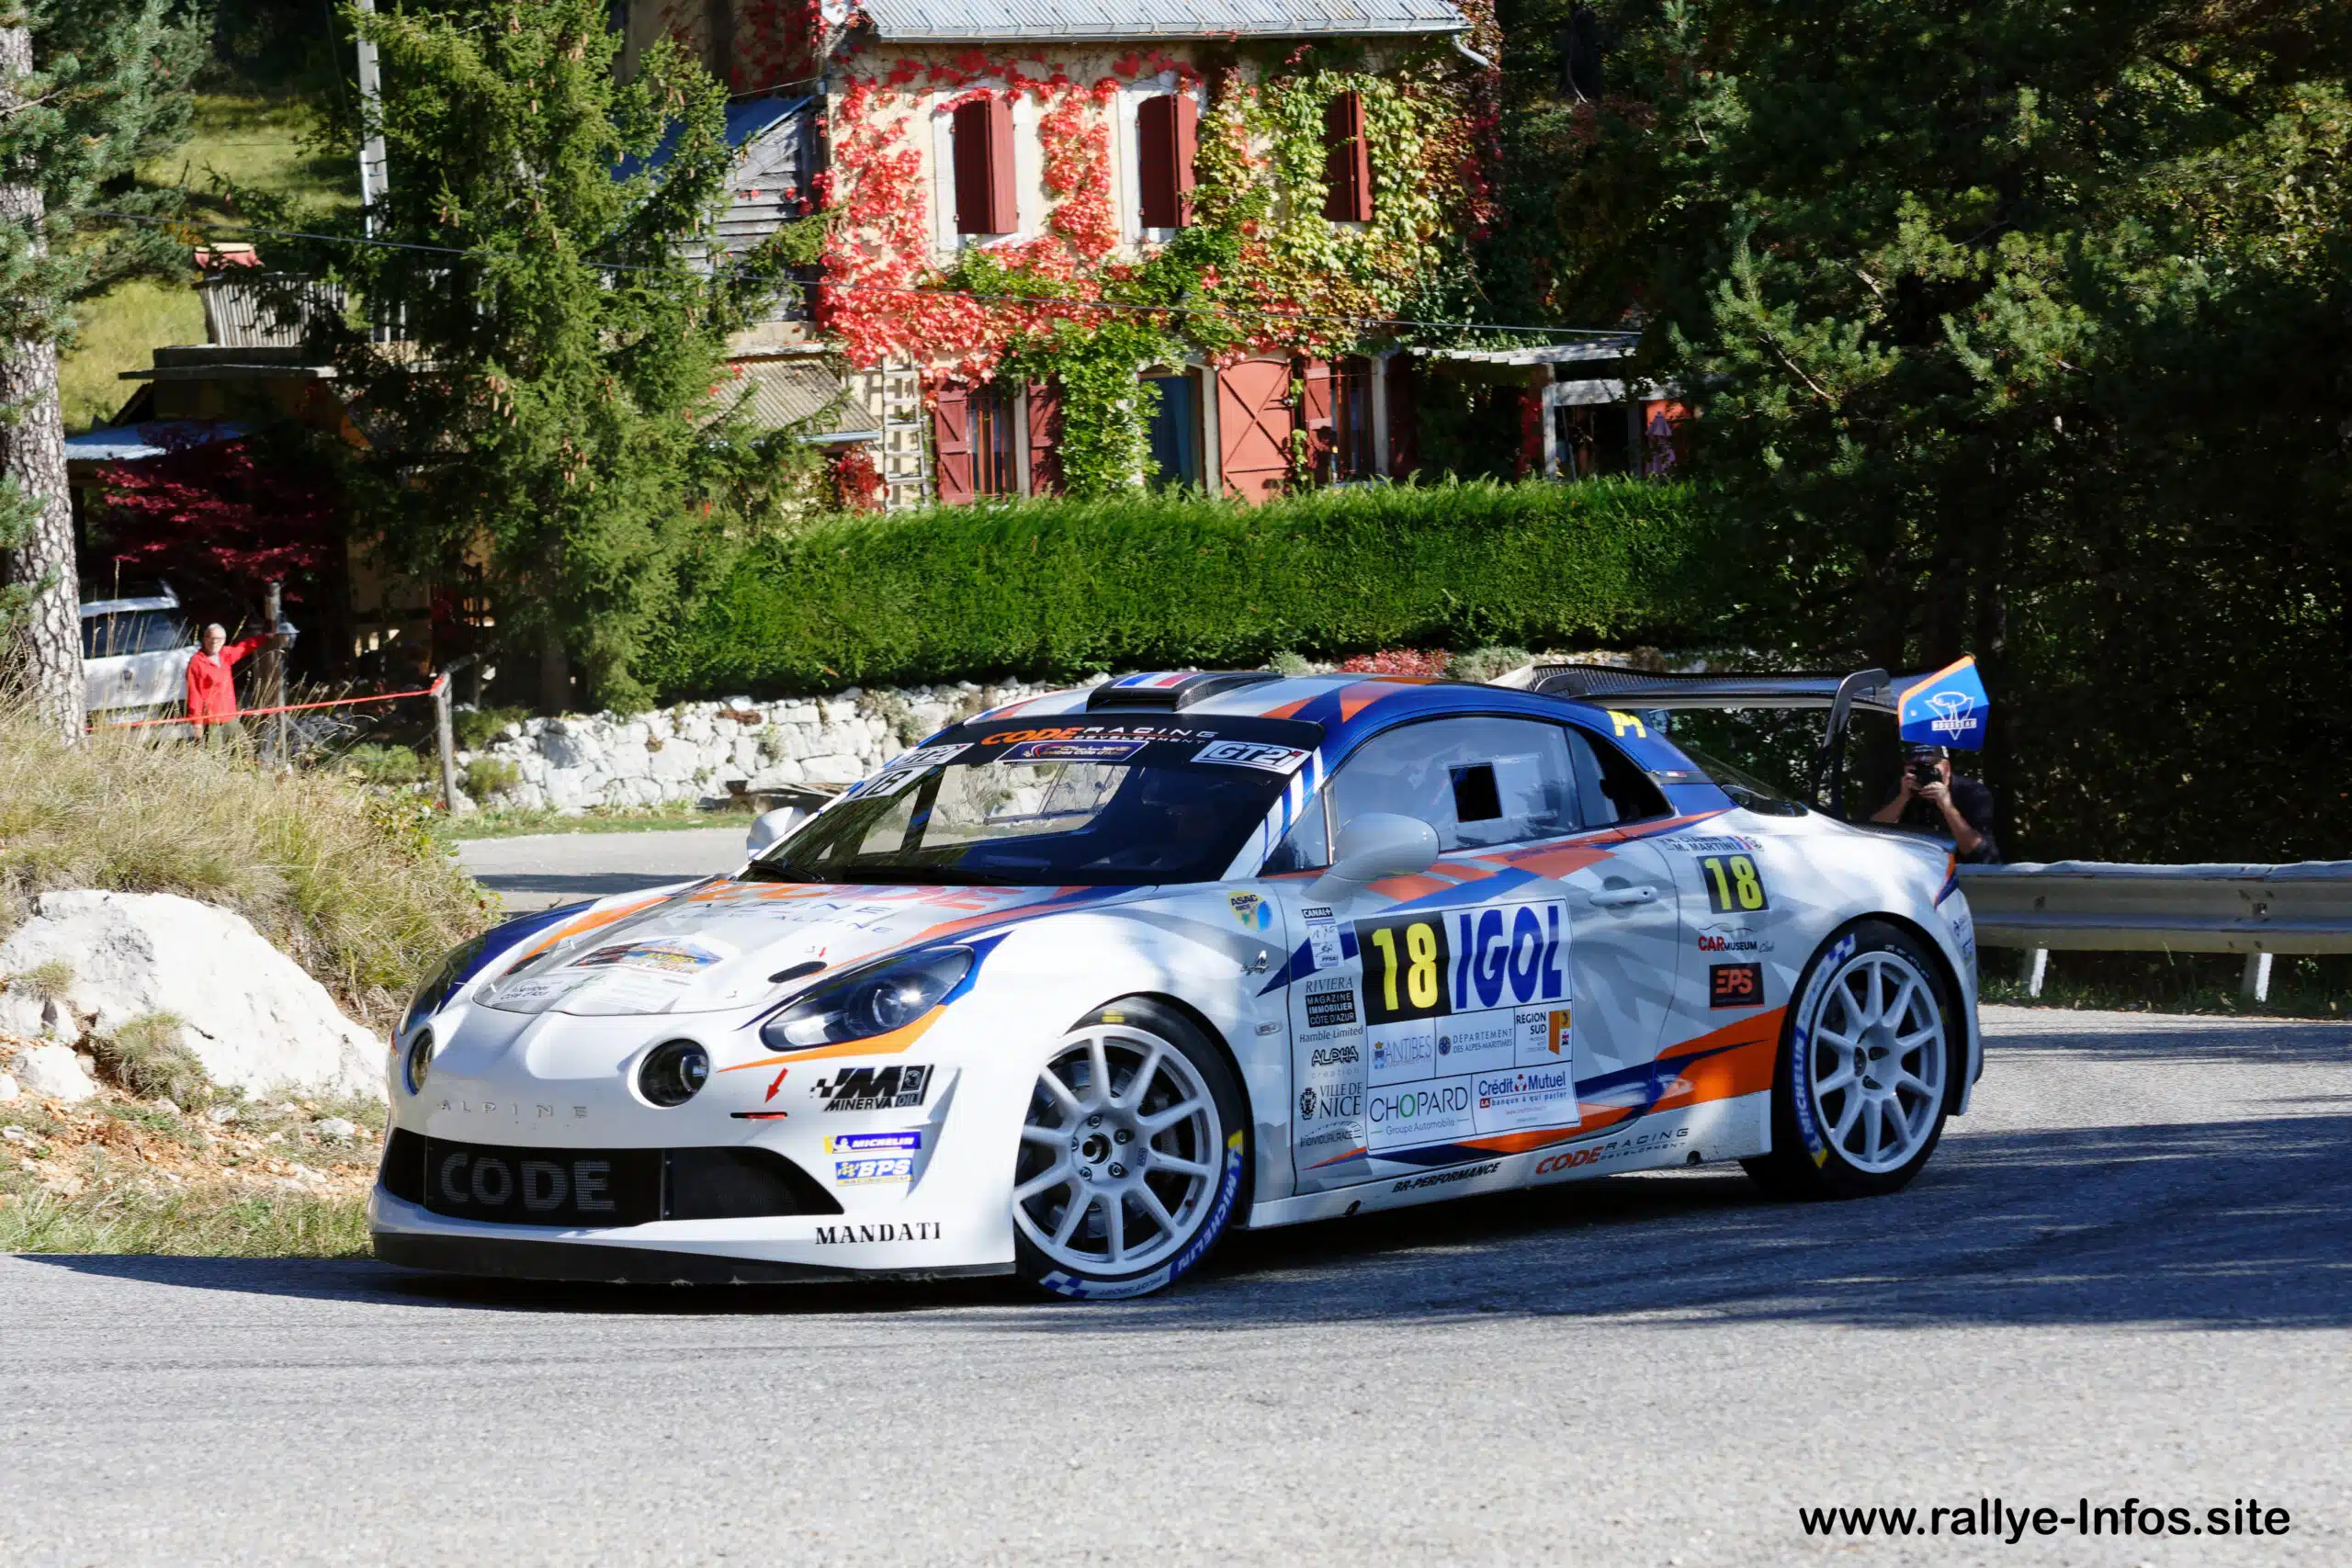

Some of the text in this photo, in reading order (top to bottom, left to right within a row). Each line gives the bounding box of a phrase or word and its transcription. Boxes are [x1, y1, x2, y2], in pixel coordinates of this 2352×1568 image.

[980, 726, 1218, 746] CODE RACING
[1073, 735, 1205, 746] DEVELOPMENT
[1689, 840, 1738, 852] MARTINI
[1704, 855, 1763, 910] 18
[1230, 894, 1258, 906] ASAC
[1303, 908, 1331, 918] CANAL+
[1698, 935, 1724, 952] CAR
[1724, 941, 1758, 951] MUSEUM
[1372, 922, 1438, 1011] 18
[1455, 905, 1562, 1010] IGOL
[1306, 977, 1353, 993] RIVIERA
[1715, 969, 1754, 995] EPS
[1307, 992, 1352, 1005] MAGAZINE
[1308, 1002, 1353, 1015] IMMOBILIER
[1309, 1012, 1355, 1025] CÔTE D'AZUR
[1516, 1011, 1547, 1025] REGION
[1299, 1025, 1363, 1043] Hamble Limited
[1530, 1023, 1547, 1035] SUD
[1385, 1034, 1432, 1061] ANTIBES
[1453, 1044, 1464, 1054] DES
[1320, 1081, 1363, 1097] VILLE DE
[1478, 1071, 1566, 1097] Crédit Mutuel
[1794, 1037, 1815, 1136] MICHELIN
[824, 1097, 892, 1111] MINERVA
[1369, 1087, 1468, 1122] CHOPARD
[1529, 1093, 1543, 1102] qui
[440, 1099, 589, 1119] ALPINE
[1319, 1096, 1362, 1119] NICE
[1385, 1118, 1455, 1135] Groupe Automobile
[852, 1137, 915, 1148] MICHELIN
[1535, 1128, 1690, 1176] CODE RACING
[857, 1158, 912, 1177] BPS
[441, 1152, 617, 1212] CODE
[1391, 1162, 1501, 1193] BR-PERFORMANCE
[1178, 1175, 1236, 1271] MICHELIN
[815, 1223, 942, 1245] MANDATI
